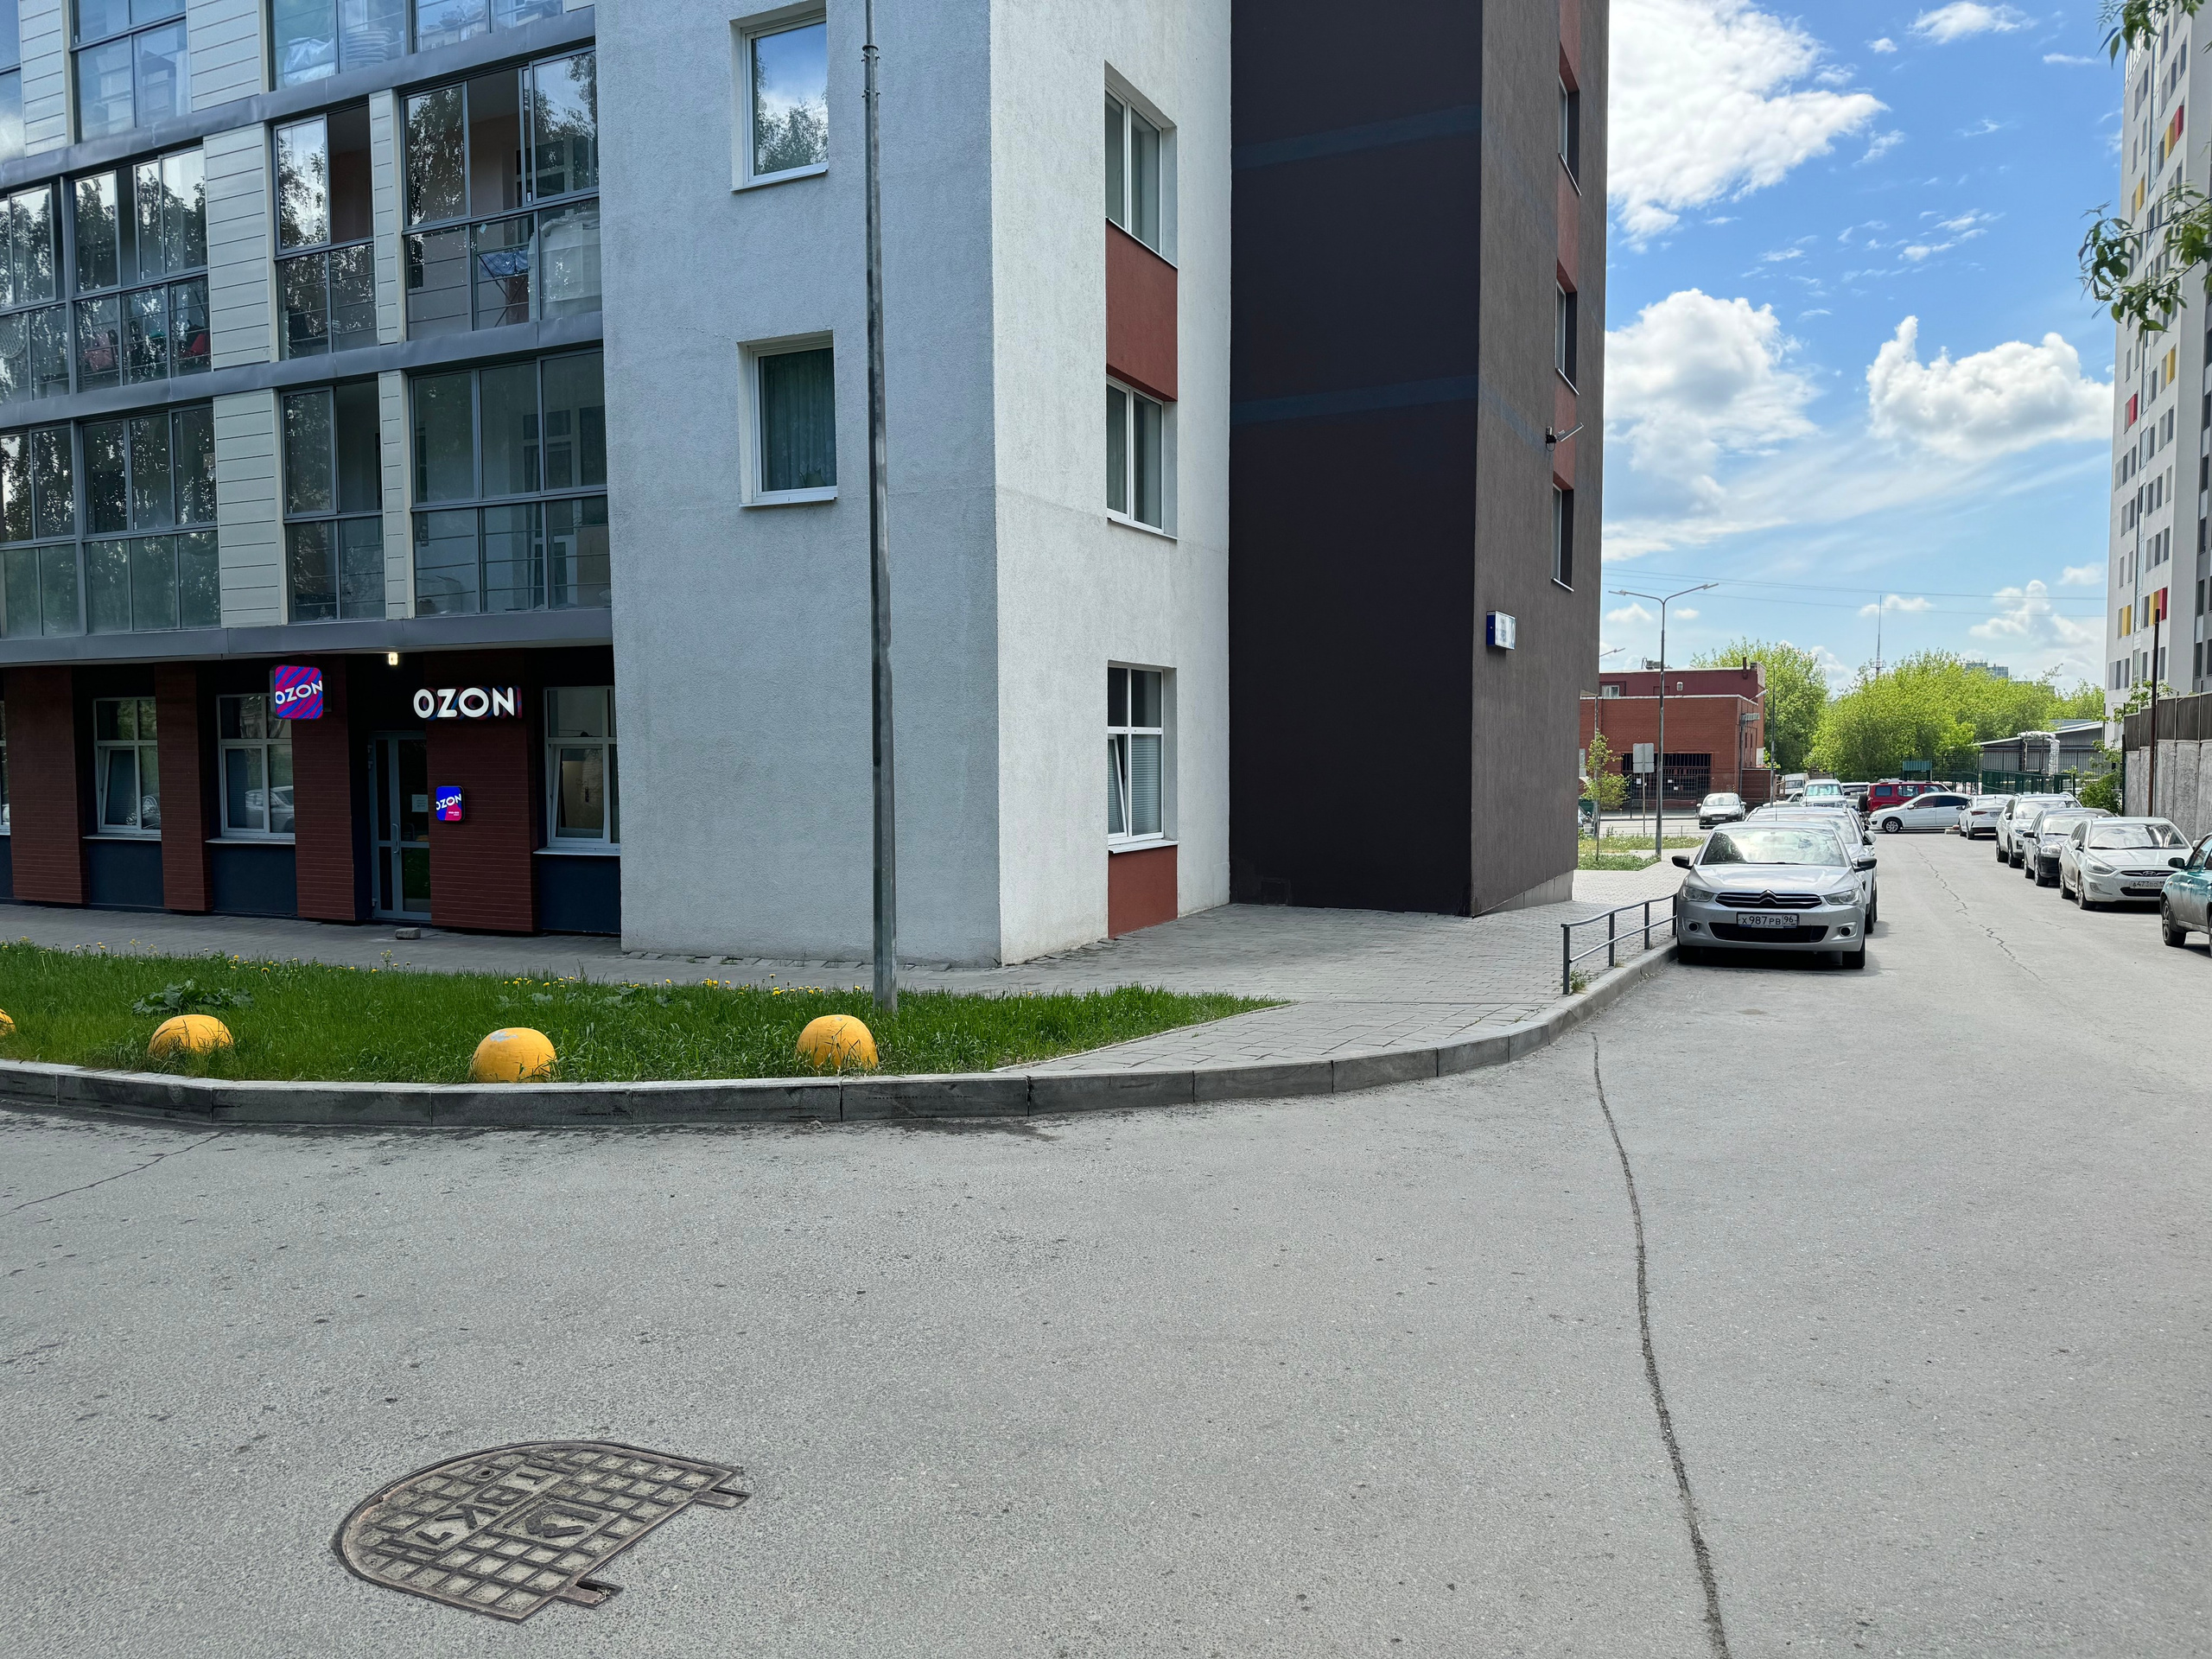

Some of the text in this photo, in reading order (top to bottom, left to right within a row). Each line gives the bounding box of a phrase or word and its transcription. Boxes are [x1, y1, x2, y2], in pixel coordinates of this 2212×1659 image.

[276, 680, 323, 705] OZON
[413, 687, 515, 719] OZON
[435, 793, 462, 810] OZON
